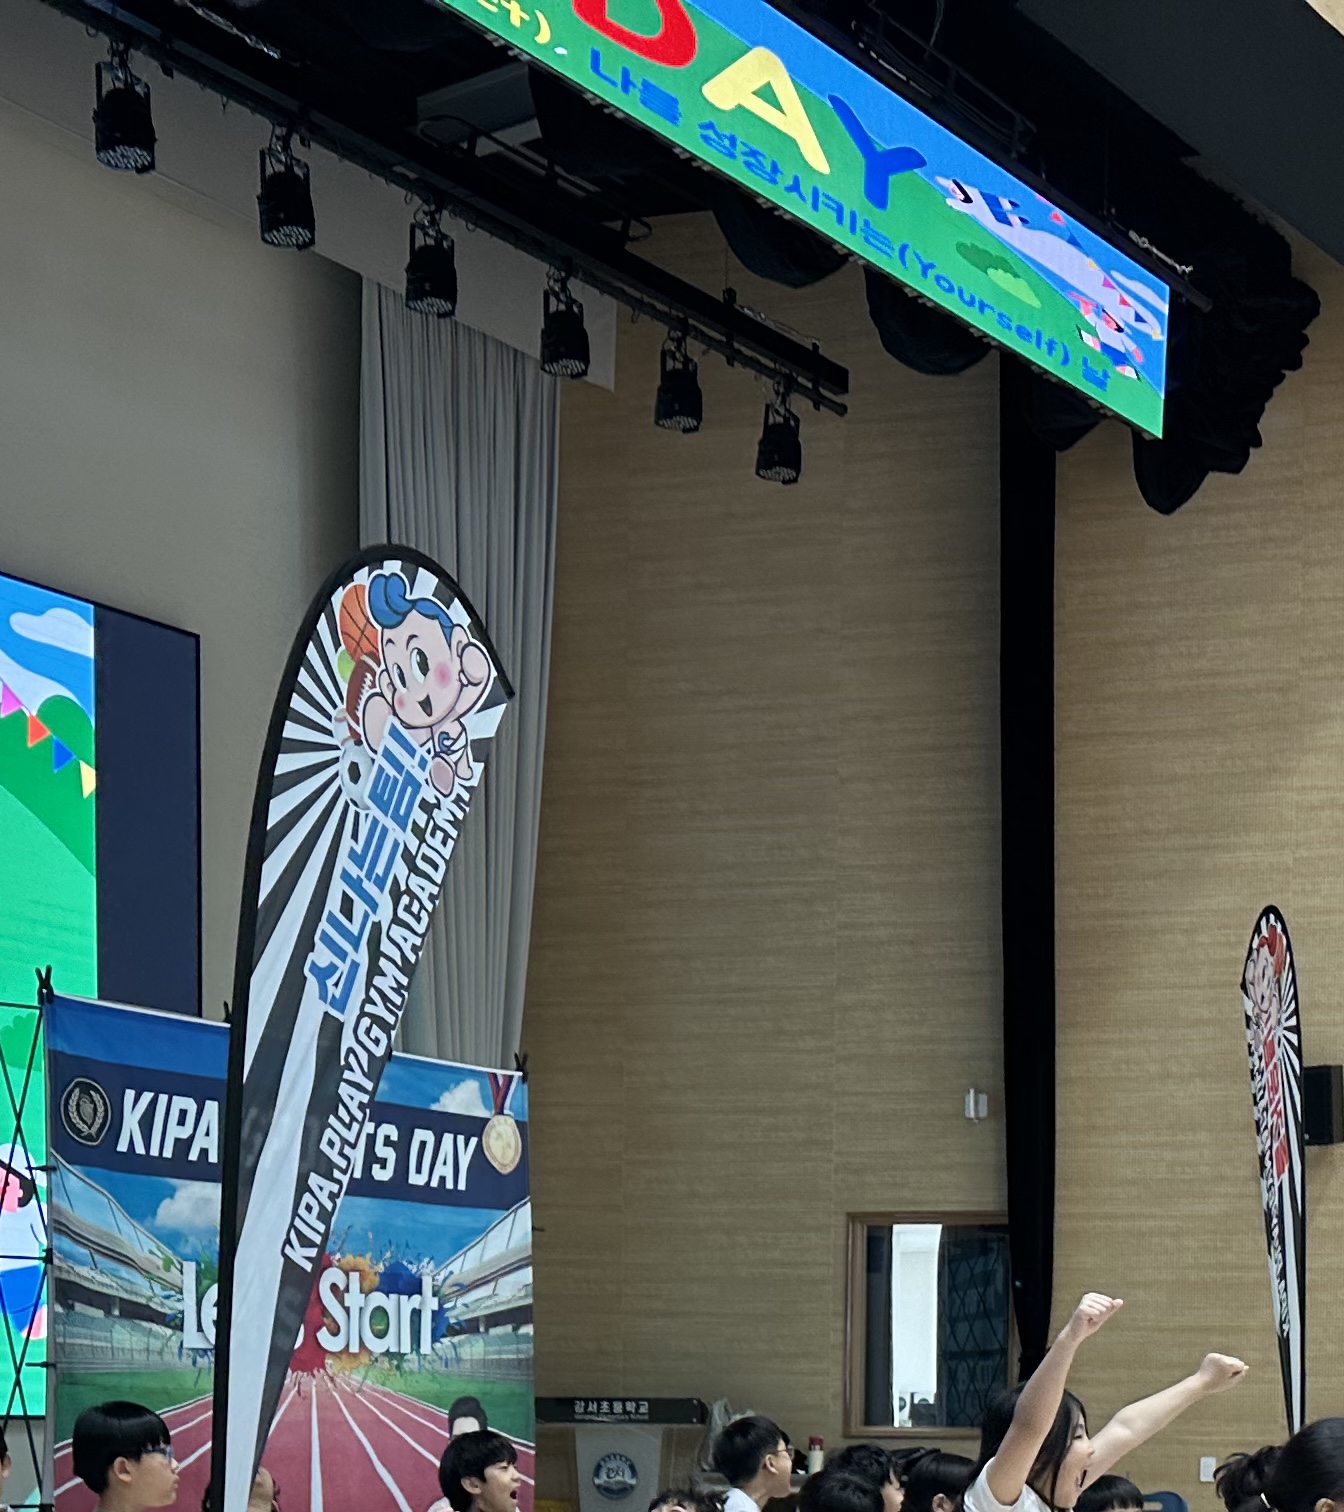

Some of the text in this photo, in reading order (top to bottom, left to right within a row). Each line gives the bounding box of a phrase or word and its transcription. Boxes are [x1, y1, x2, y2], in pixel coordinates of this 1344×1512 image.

[590, 47, 682, 127] 나를
[116, 1088, 220, 1164] KIPA
[283, 1172, 340, 1273] KIPA
[320, 1048, 374, 1170] PLAY
[357, 955, 409, 1057] GYM
[408, 1128, 479, 1191] DAY
[316, 1267, 439, 1354] Start
